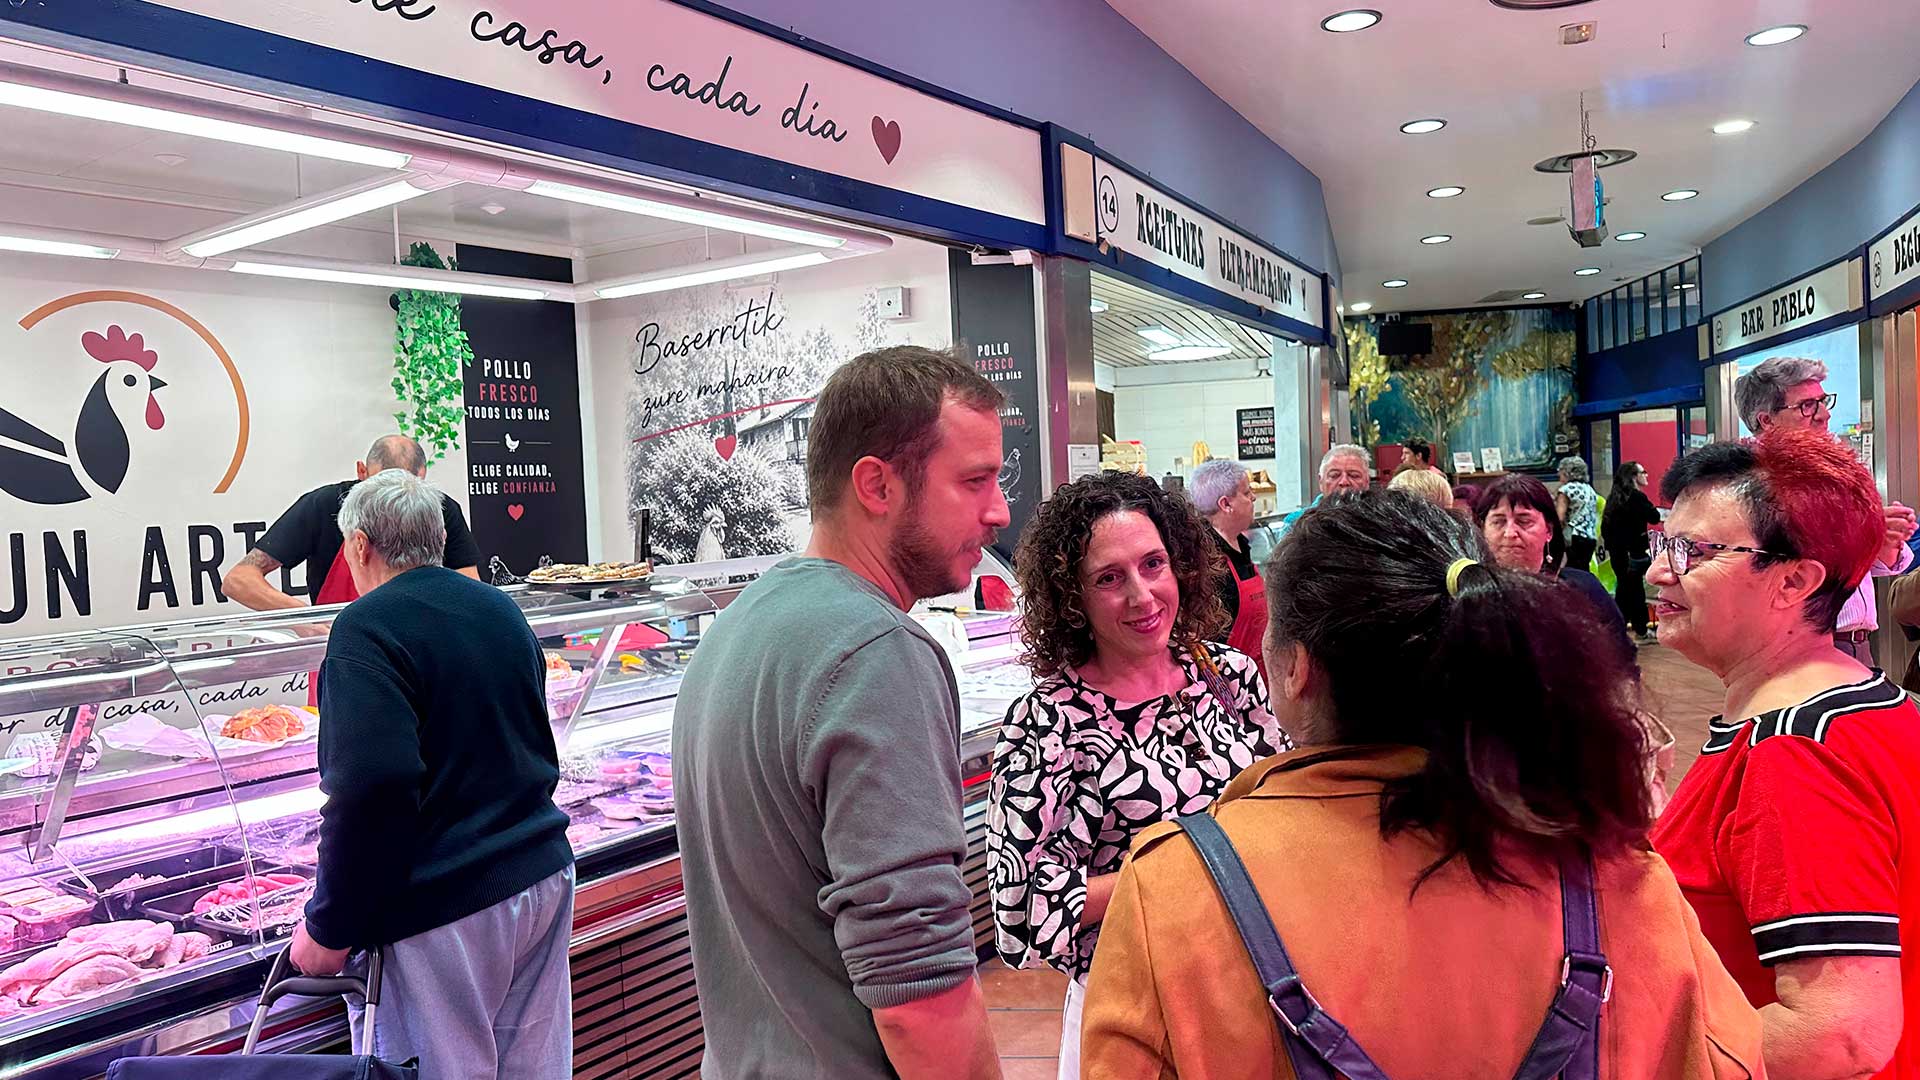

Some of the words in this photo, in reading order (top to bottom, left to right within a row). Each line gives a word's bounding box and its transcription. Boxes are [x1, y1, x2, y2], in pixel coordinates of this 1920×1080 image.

[470, 11, 611, 84] casa,
[647, 56, 764, 116] cada
[1102, 192, 1116, 218] 14
[1136, 192, 1205, 270] ACEITUNAS
[1218, 236, 1291, 306] ULTRAMARINOS
[1741, 305, 1764, 338] BAR
[1772, 285, 1815, 328] PABLO
[635, 291, 785, 374] Baserritik
[978, 342, 1009, 357] POLLO
[483, 358, 532, 380] POLLO
[975, 357, 1013, 371] FRESCO
[991, 372, 1003, 381] LOS
[479, 382, 538, 404] FRESCO
[642, 389, 689, 428] zure
[696, 359, 795, 399] mahaira
[468, 405, 500, 420] TODOS
[505, 407, 523, 420] LOS
[528, 406, 550, 421] DÍAS
[472, 464, 501, 477] ELIGE
[506, 464, 552, 478] CALIDAD,
[470, 482, 498, 495] ELIGE
[503, 481, 556, 494] CONFIANZA
[104, 697, 179, 720] casa,
[199, 680, 268, 706] cada
[281, 672, 309, 694] dí
